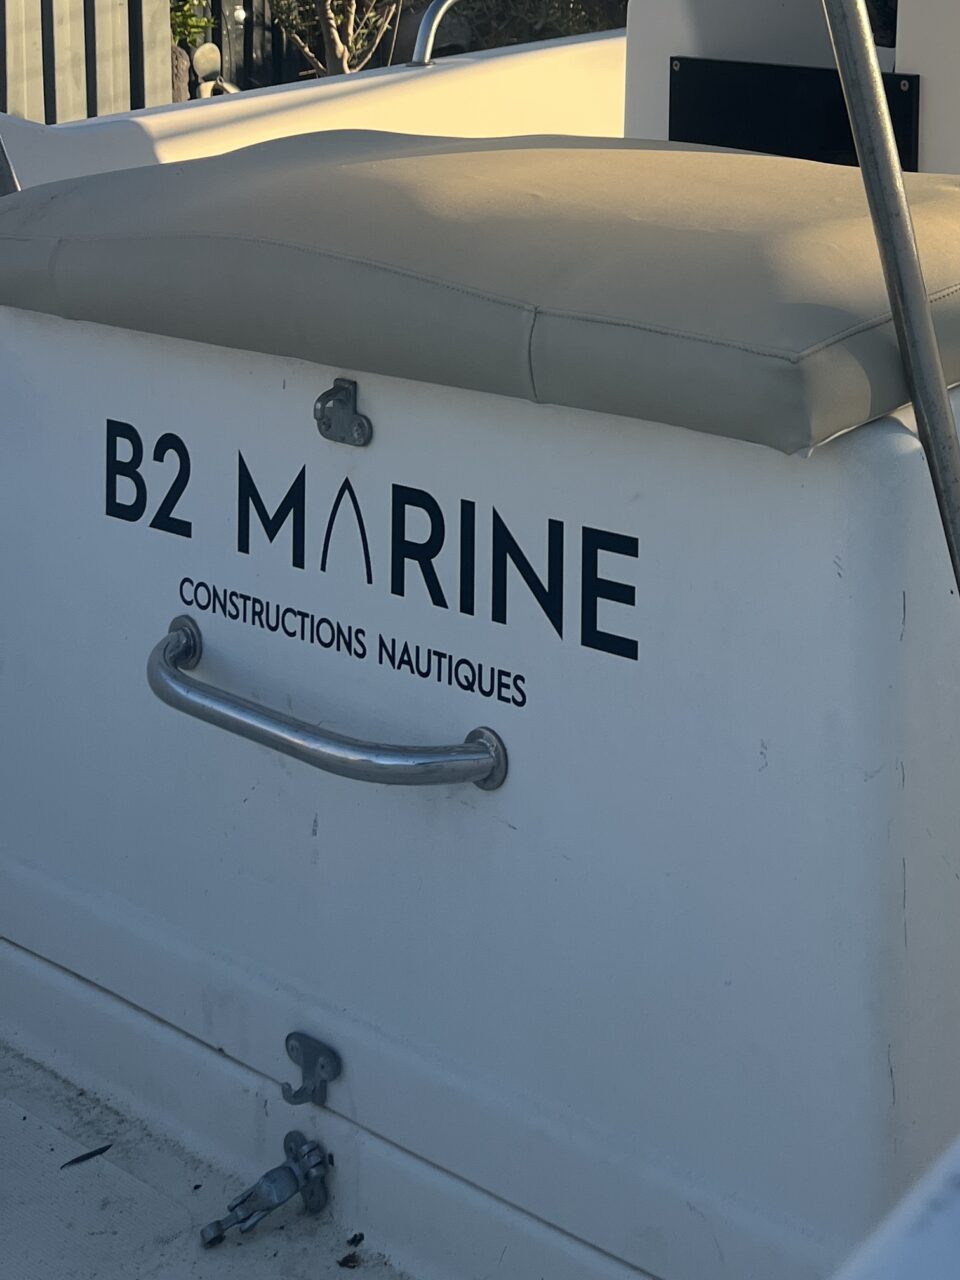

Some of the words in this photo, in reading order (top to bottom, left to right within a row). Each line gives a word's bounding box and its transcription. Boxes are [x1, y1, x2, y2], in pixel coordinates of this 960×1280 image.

[105, 418, 193, 539] B2
[237, 449, 639, 661] MARINE
[178, 576, 367, 660] CONSTRUCTIONS
[378, 633, 527, 708] NAUTIQUES
